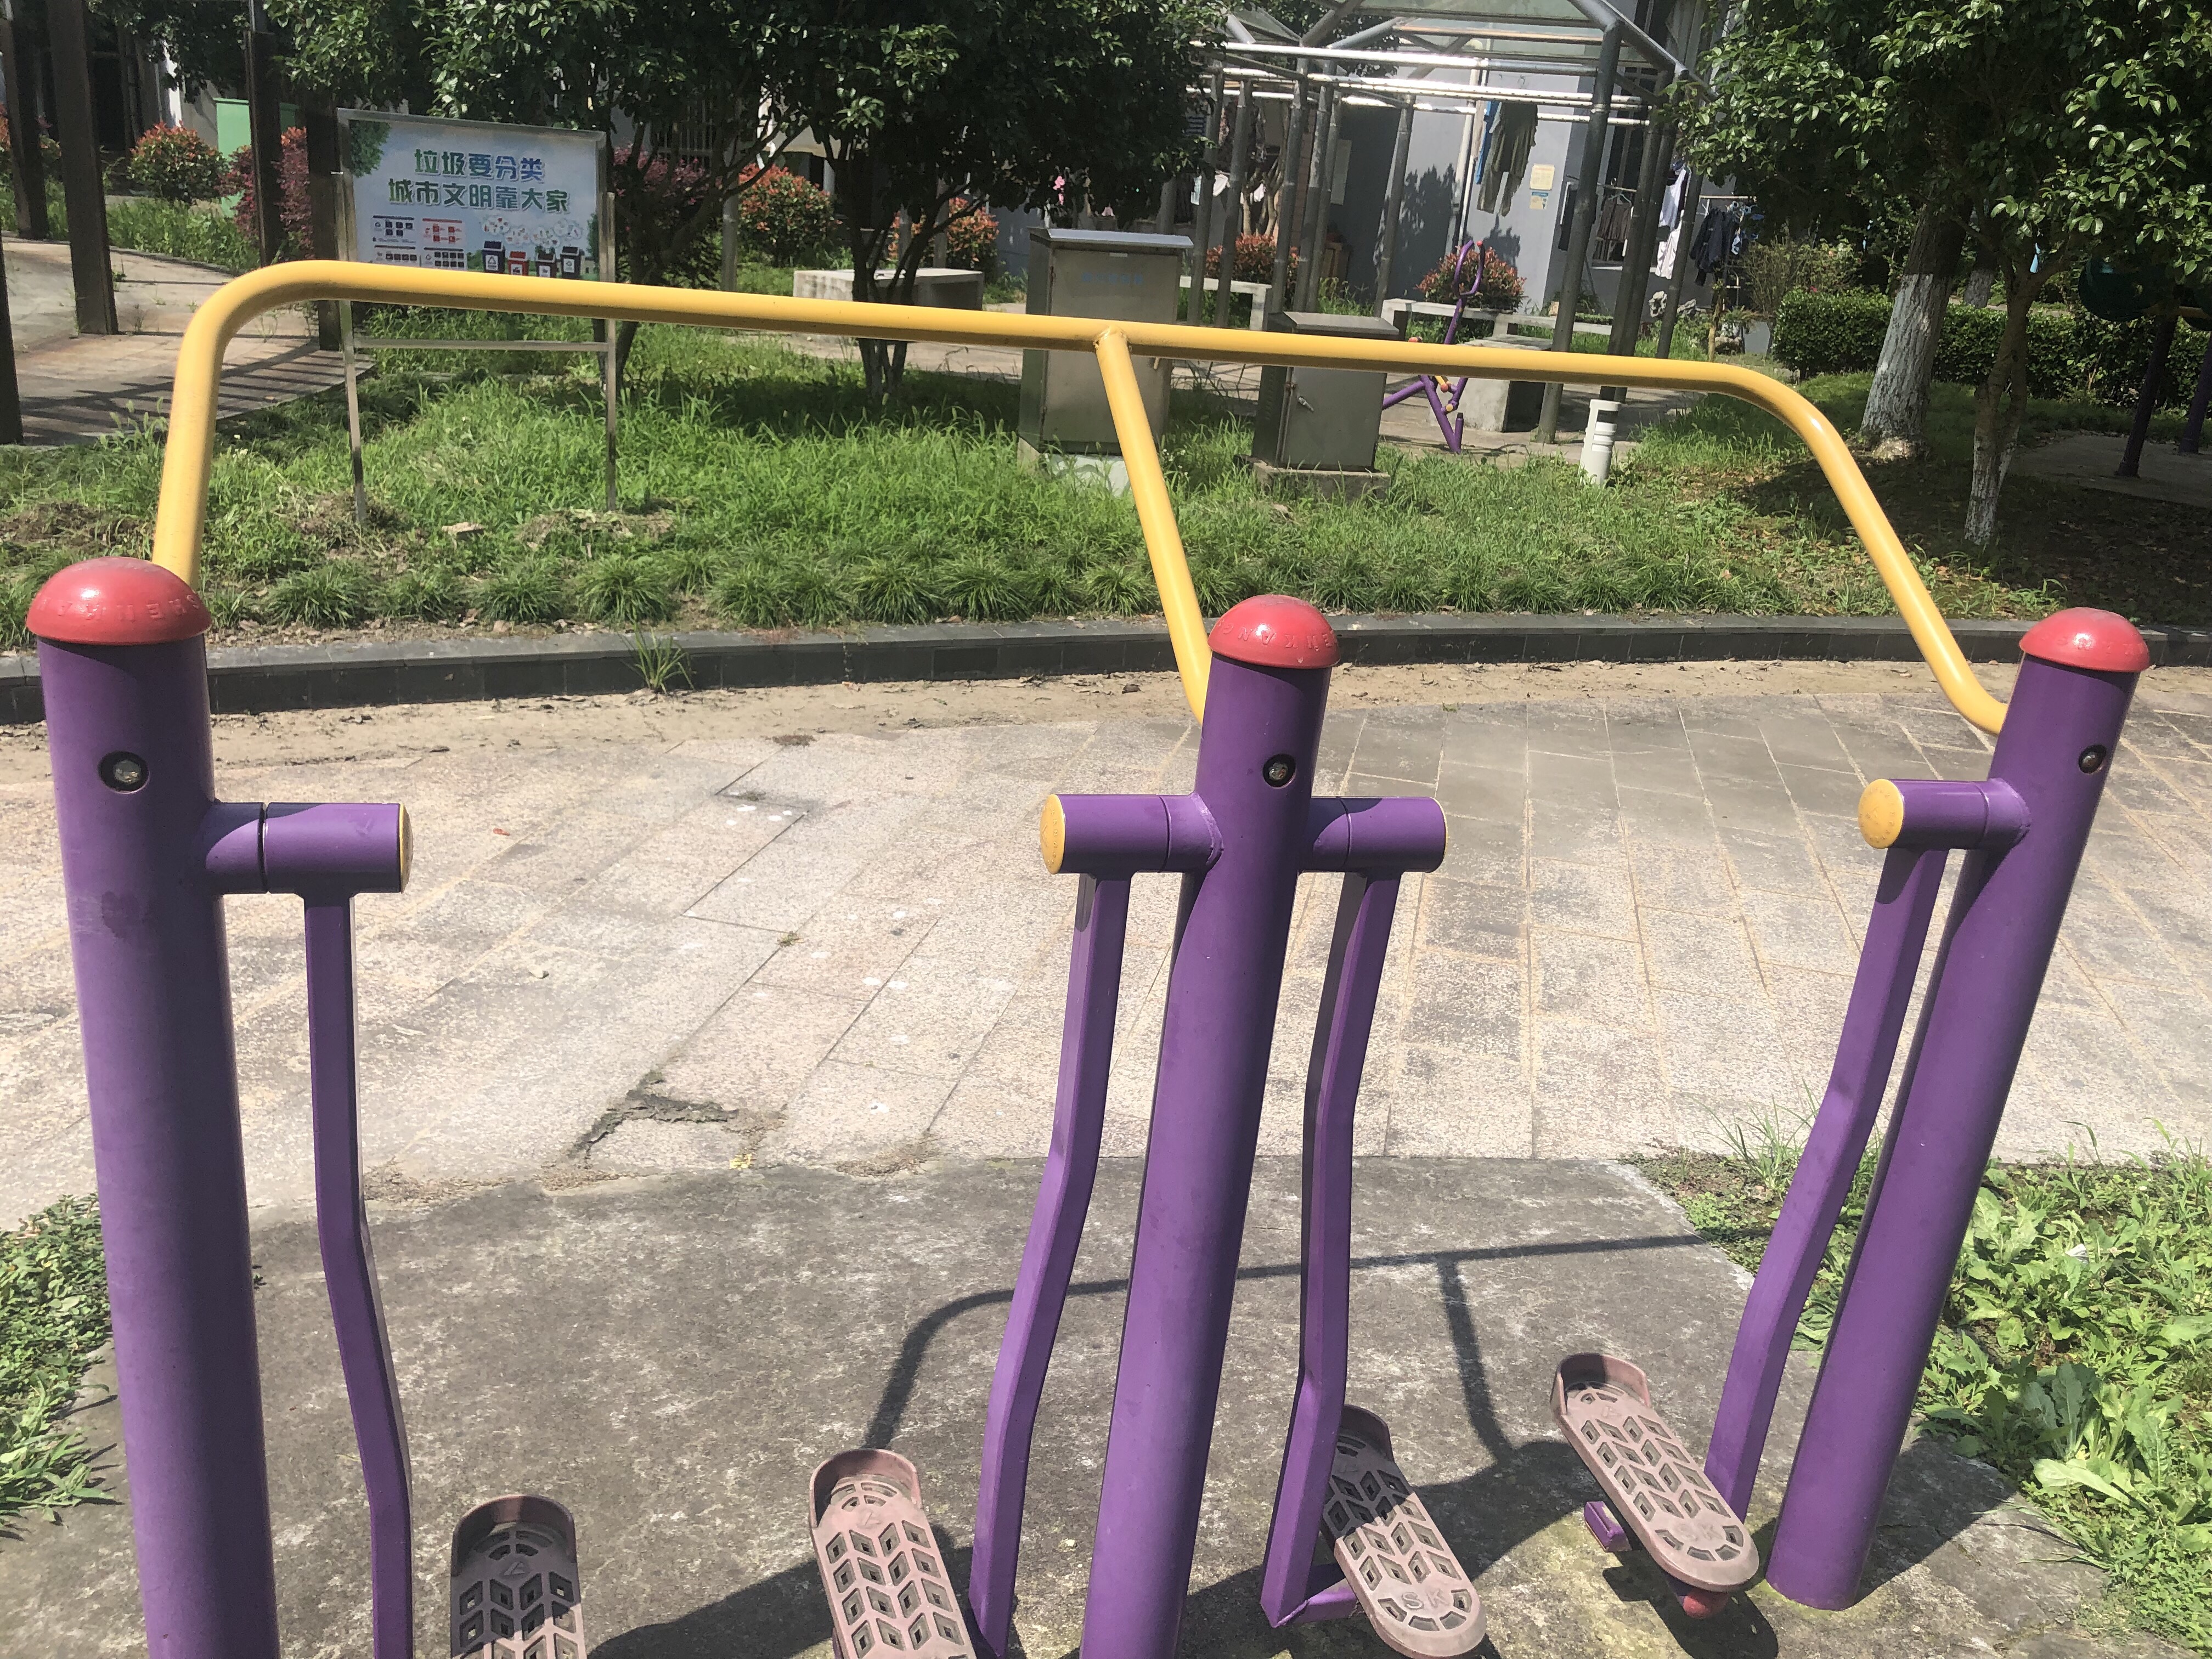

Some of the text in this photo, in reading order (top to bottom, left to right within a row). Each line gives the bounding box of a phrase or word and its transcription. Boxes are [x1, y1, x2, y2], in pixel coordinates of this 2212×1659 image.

[414, 148, 544, 182] 垃圾要分类
[387, 177, 569, 213] 城市文明靠大家
